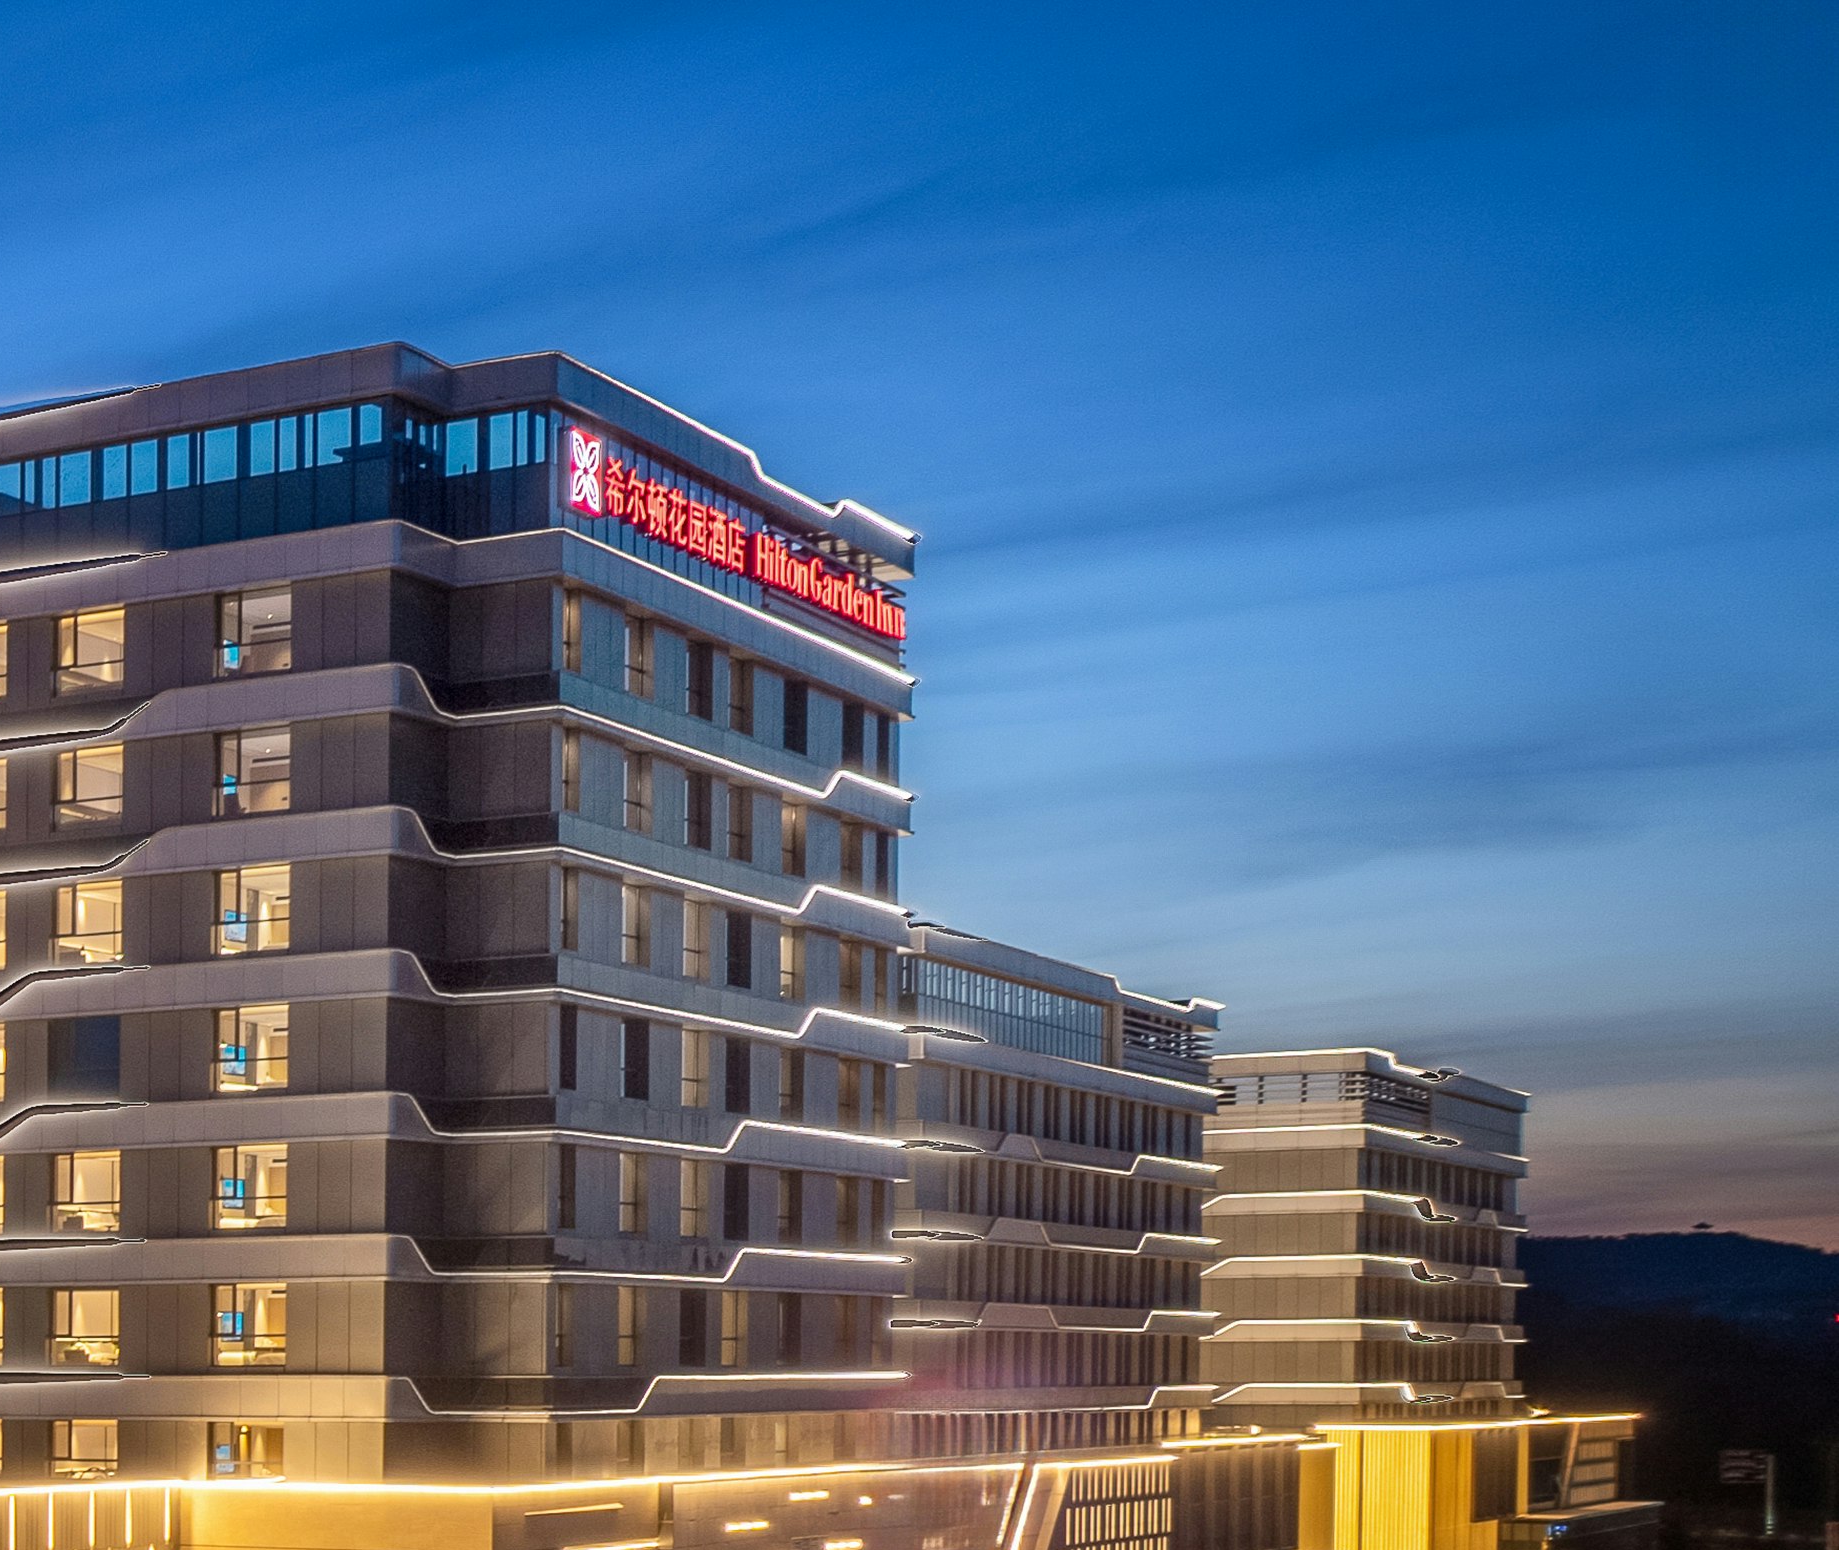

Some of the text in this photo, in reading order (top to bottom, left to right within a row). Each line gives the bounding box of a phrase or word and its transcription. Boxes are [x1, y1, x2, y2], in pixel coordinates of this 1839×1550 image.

[605, 456, 746, 574] 希尔顿花园酒店
[756, 532, 906, 640] Hilton Garden Inn
